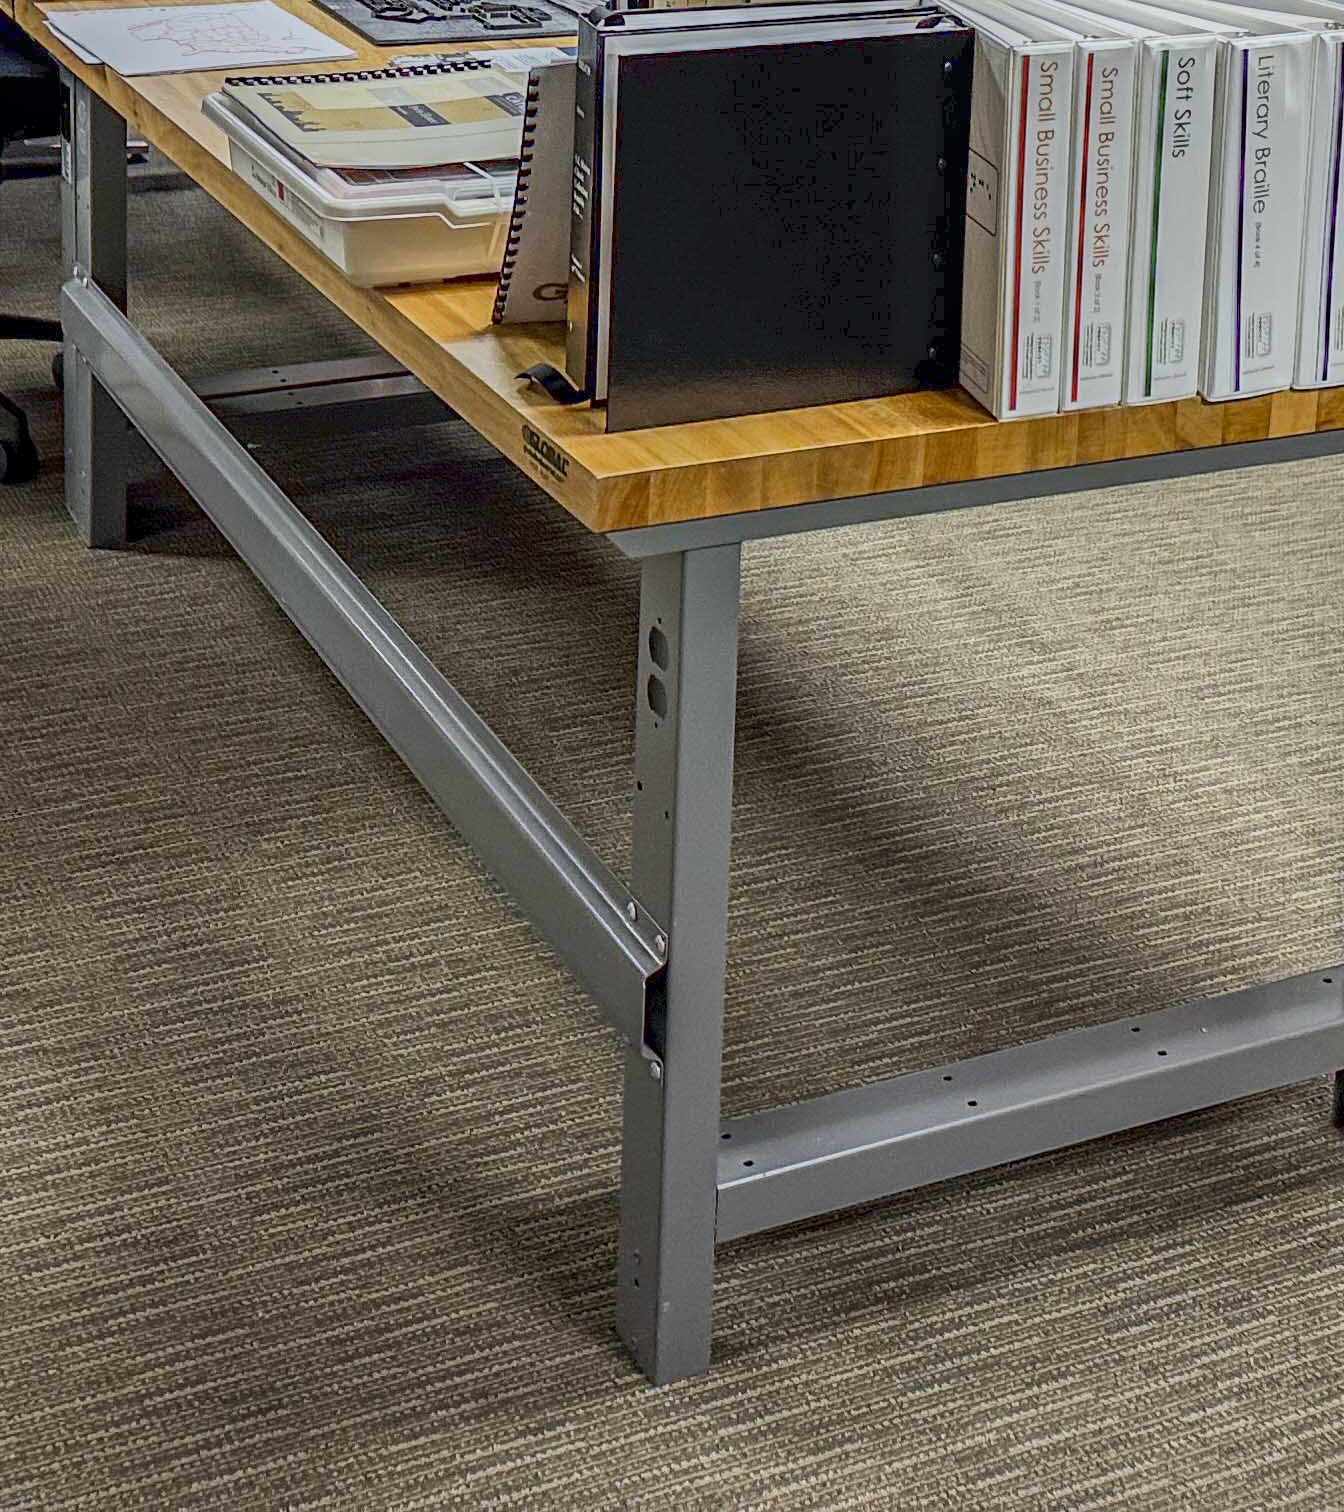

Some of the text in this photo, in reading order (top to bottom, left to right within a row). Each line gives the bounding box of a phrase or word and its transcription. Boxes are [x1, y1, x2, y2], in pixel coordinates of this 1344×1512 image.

[1038, 61, 1058, 122] Small
[1098, 66, 1118, 125] Small
[1172, 56, 1195, 159] Soft Skills
[1252, 54, 1274, 140] Literary
[1033, 128, 1055, 220] Business
[1094, 131, 1115, 217] Business
[1252, 147, 1271, 214] Braille
[1031, 227, 1050, 274] Skills
[1092, 222, 1111, 268] Skills
